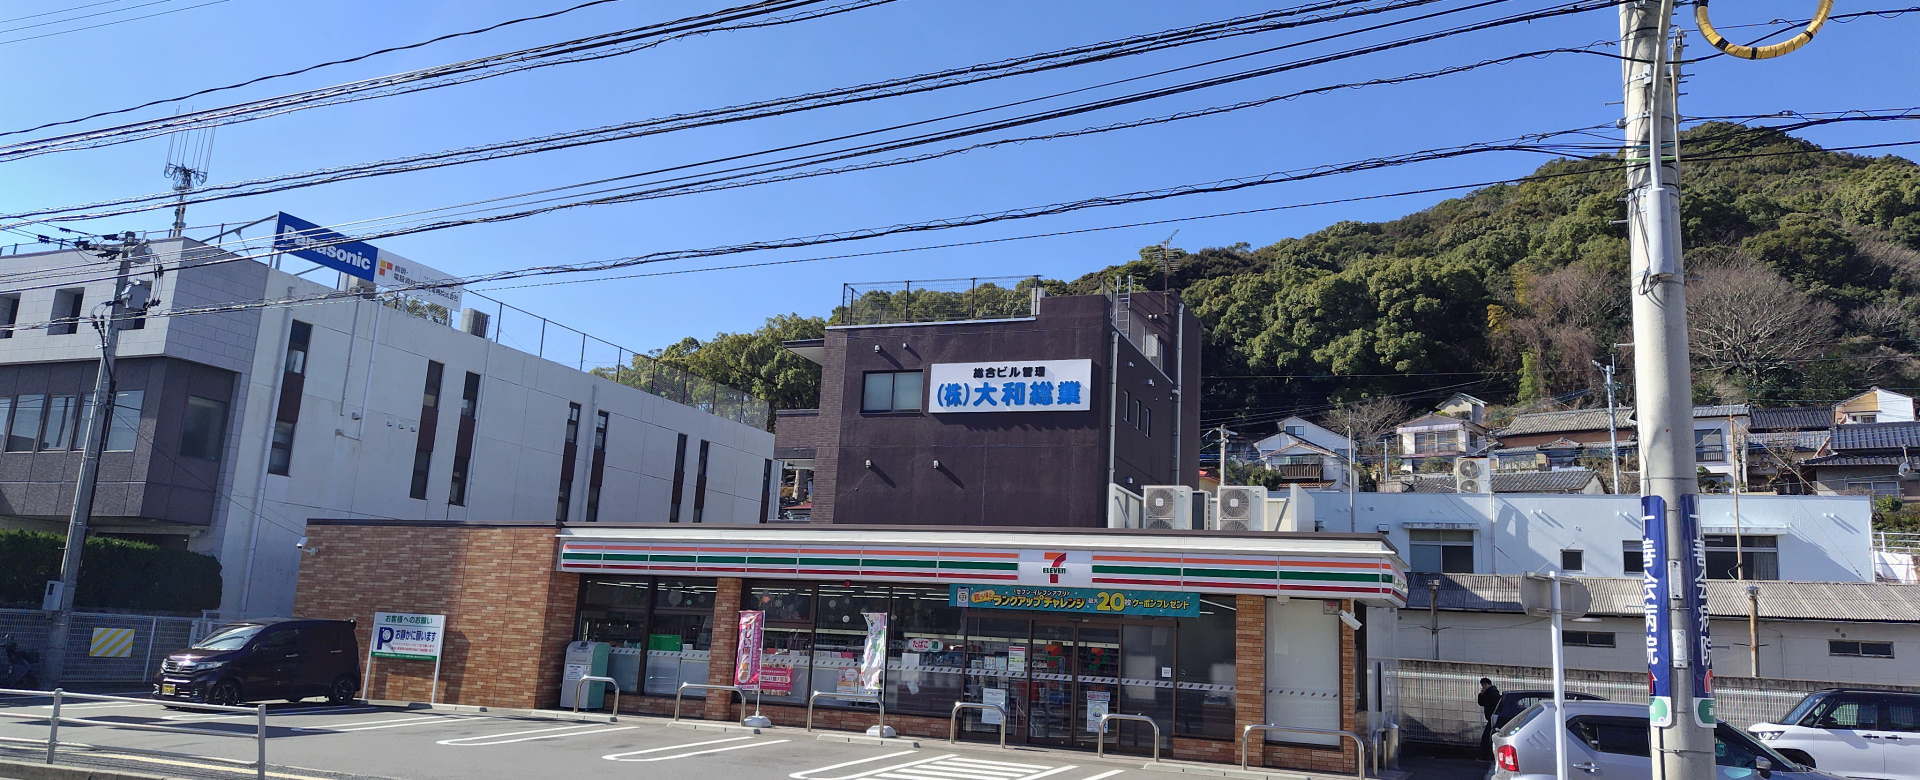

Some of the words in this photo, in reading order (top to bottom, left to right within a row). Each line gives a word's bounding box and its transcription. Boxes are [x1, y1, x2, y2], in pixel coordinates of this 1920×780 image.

[283, 224, 371, 270] Panasonic
[973, 366, 1046, 378] 総合ビル管理
[937, 380, 1081, 408] (株)大和総業
[385, 615, 433, 624] お客様へのお願い
